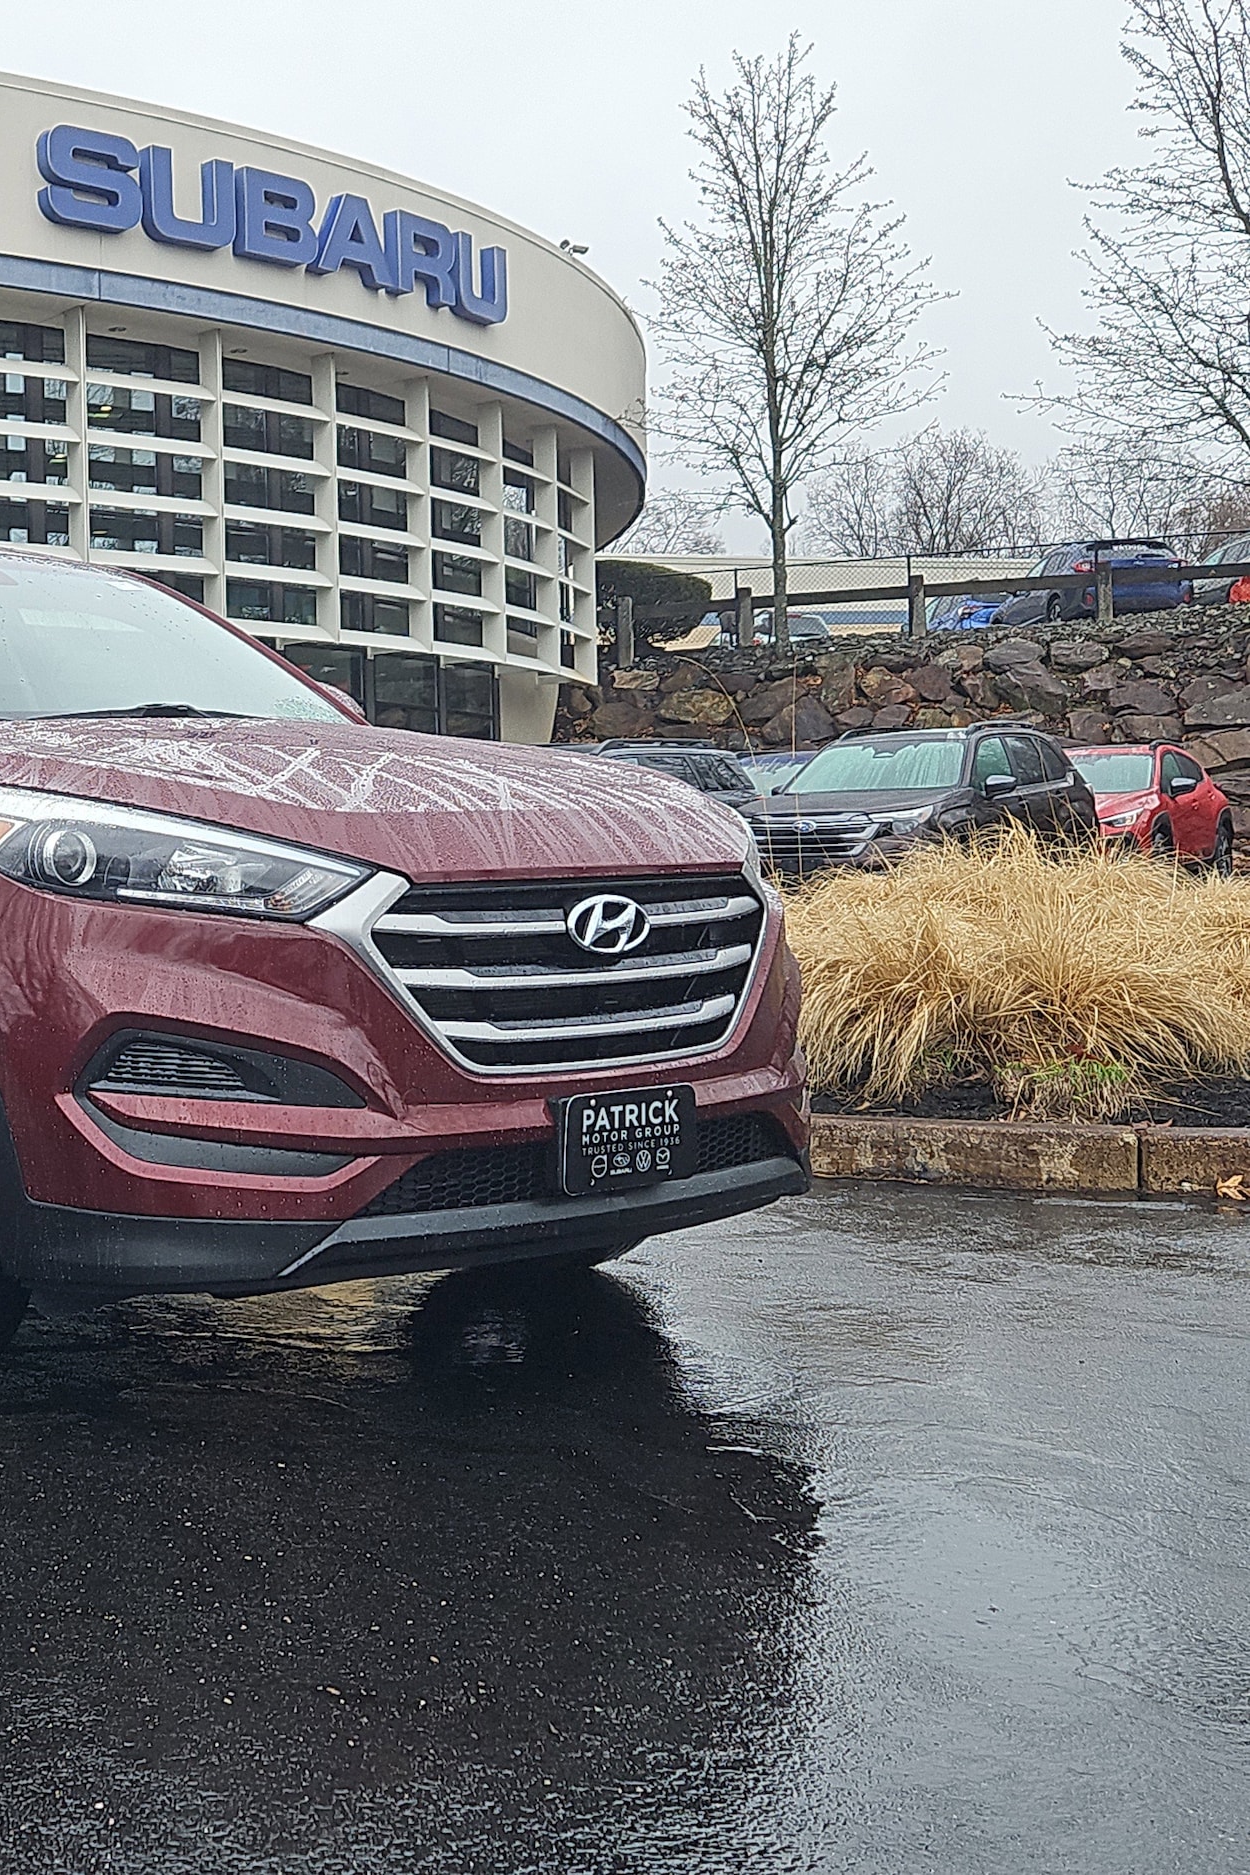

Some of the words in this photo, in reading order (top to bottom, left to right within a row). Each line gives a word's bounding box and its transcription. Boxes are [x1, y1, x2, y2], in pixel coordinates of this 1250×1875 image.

[35, 124, 509, 327] SUBARU
[582, 1099, 679, 1133] PATRICK
[582, 1129, 628, 1146] MOTOR
[635, 1123, 680, 1139] GROUP
[582, 1143, 624, 1157] TRUSTED
[628, 1139, 656, 1151] SINCE
[659, 1136, 681, 1147] 1936
